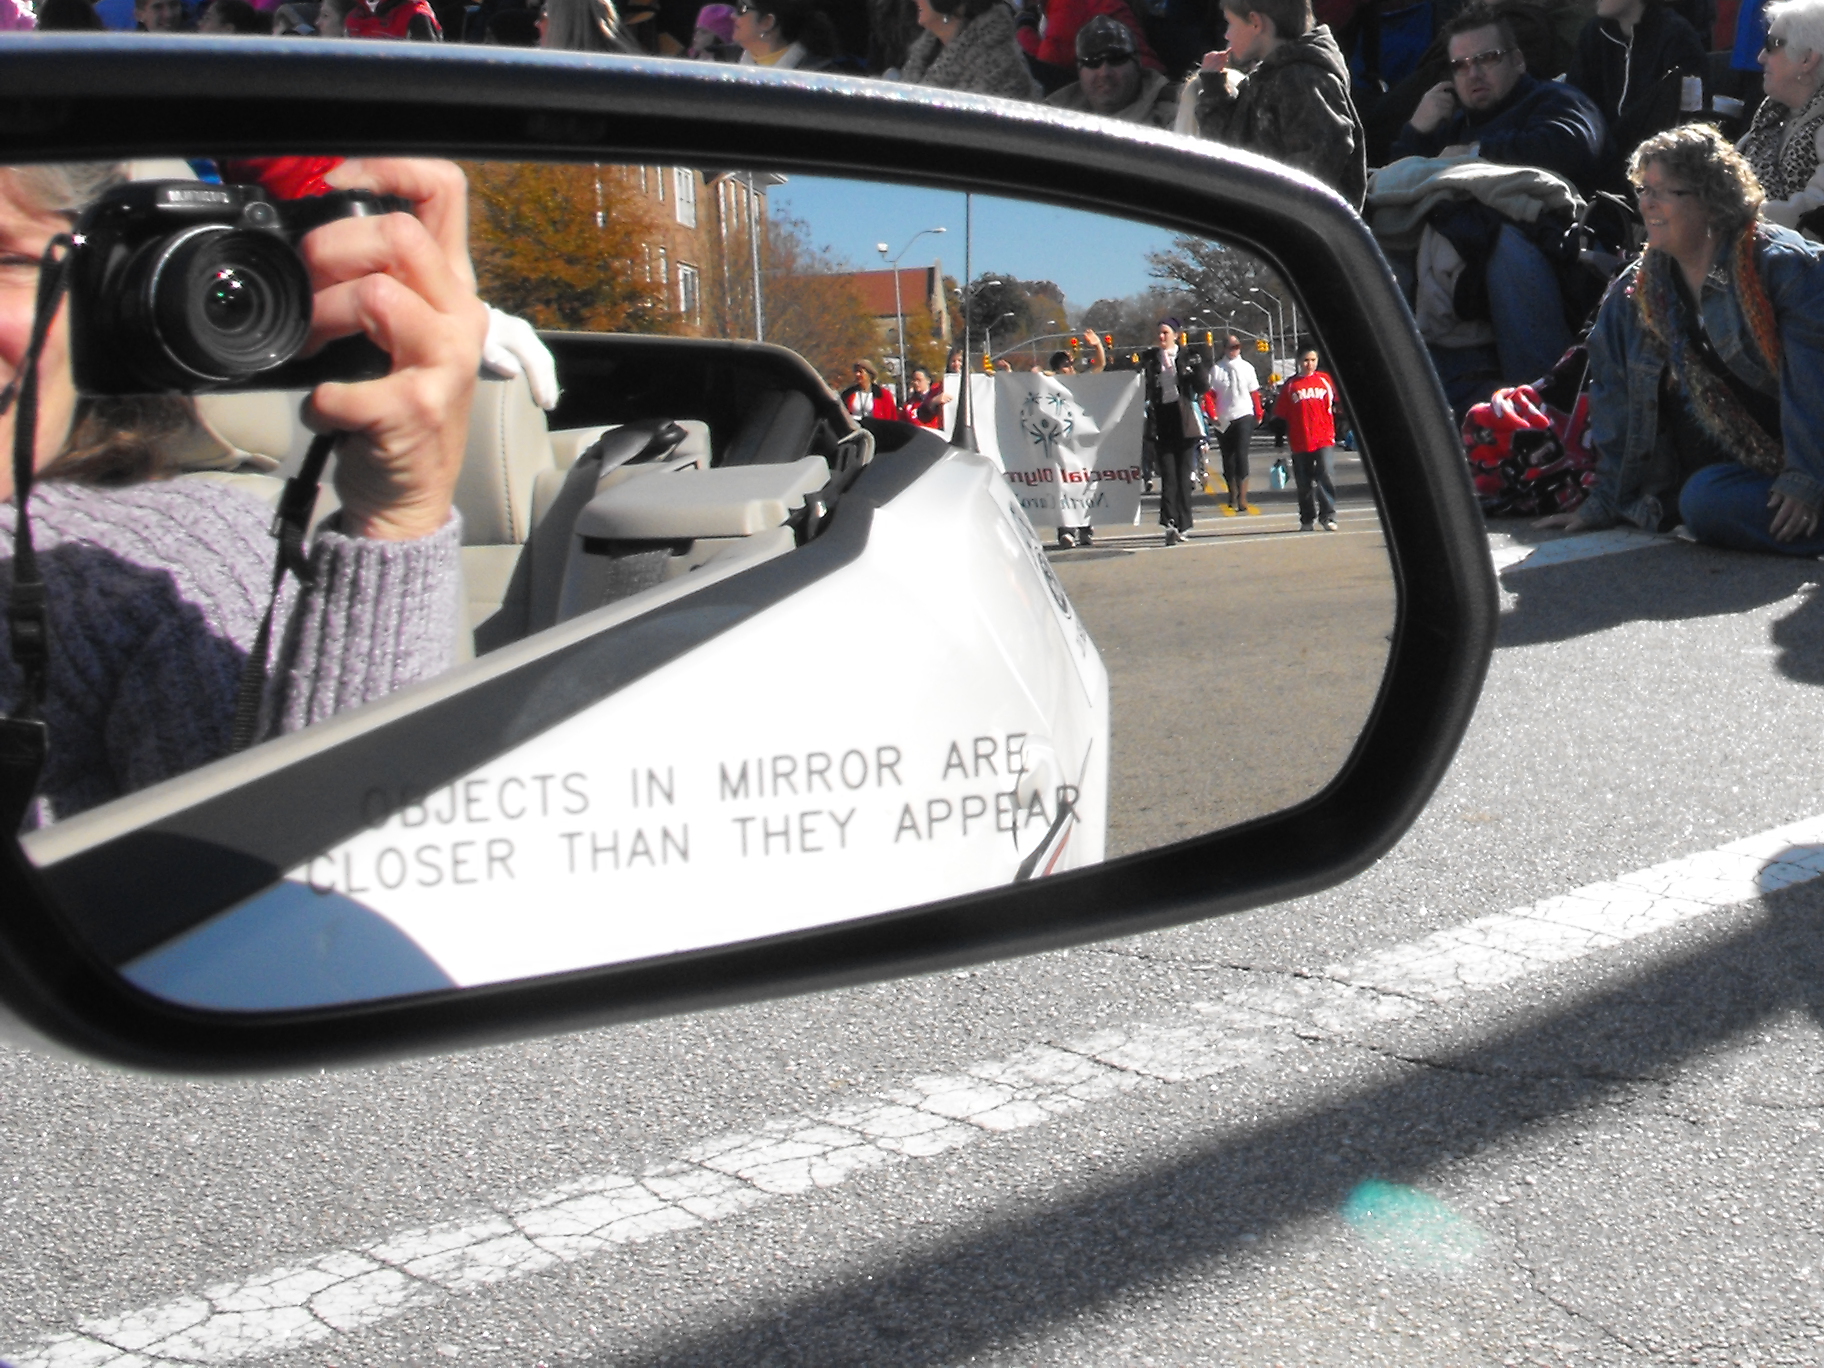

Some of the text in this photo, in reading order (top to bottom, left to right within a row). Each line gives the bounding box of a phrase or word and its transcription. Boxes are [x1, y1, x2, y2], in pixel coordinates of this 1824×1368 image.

[360, 732, 1029, 831] OBJECTS IN MIRROR ARE
[307, 785, 1081, 896] CLOSER THAN THEY APPEAR
